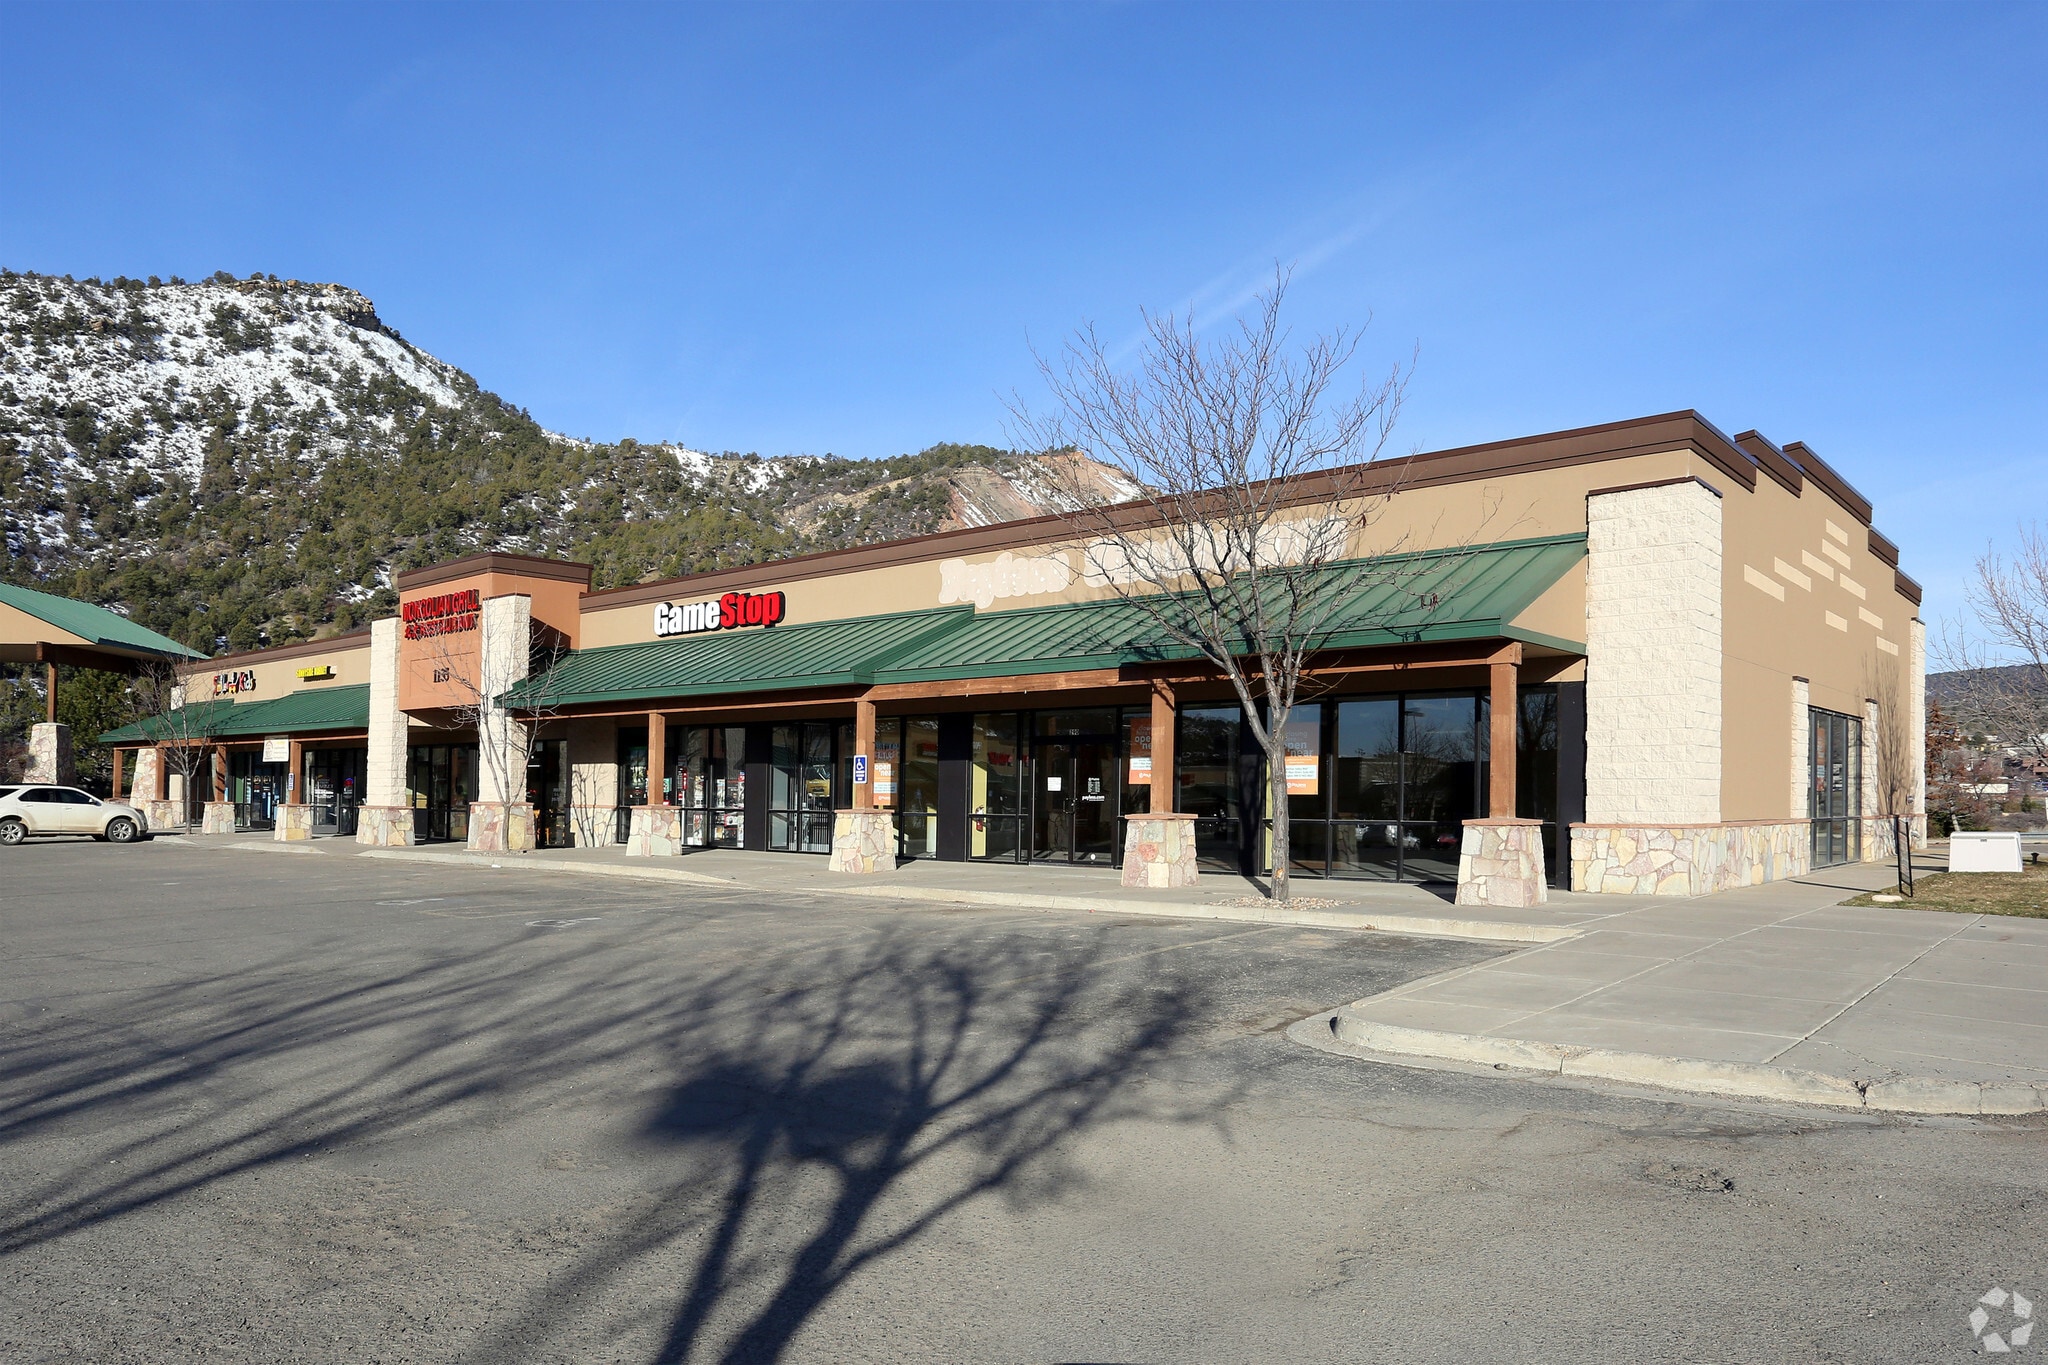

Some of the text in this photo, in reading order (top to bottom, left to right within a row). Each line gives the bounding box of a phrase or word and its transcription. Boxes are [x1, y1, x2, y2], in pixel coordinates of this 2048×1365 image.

[403, 588, 481, 622] MONGOLIAN GRILL
[654, 592, 785, 637] GameStop
[1134, 736, 1151, 745] ope
[874, 763, 892, 775] open
